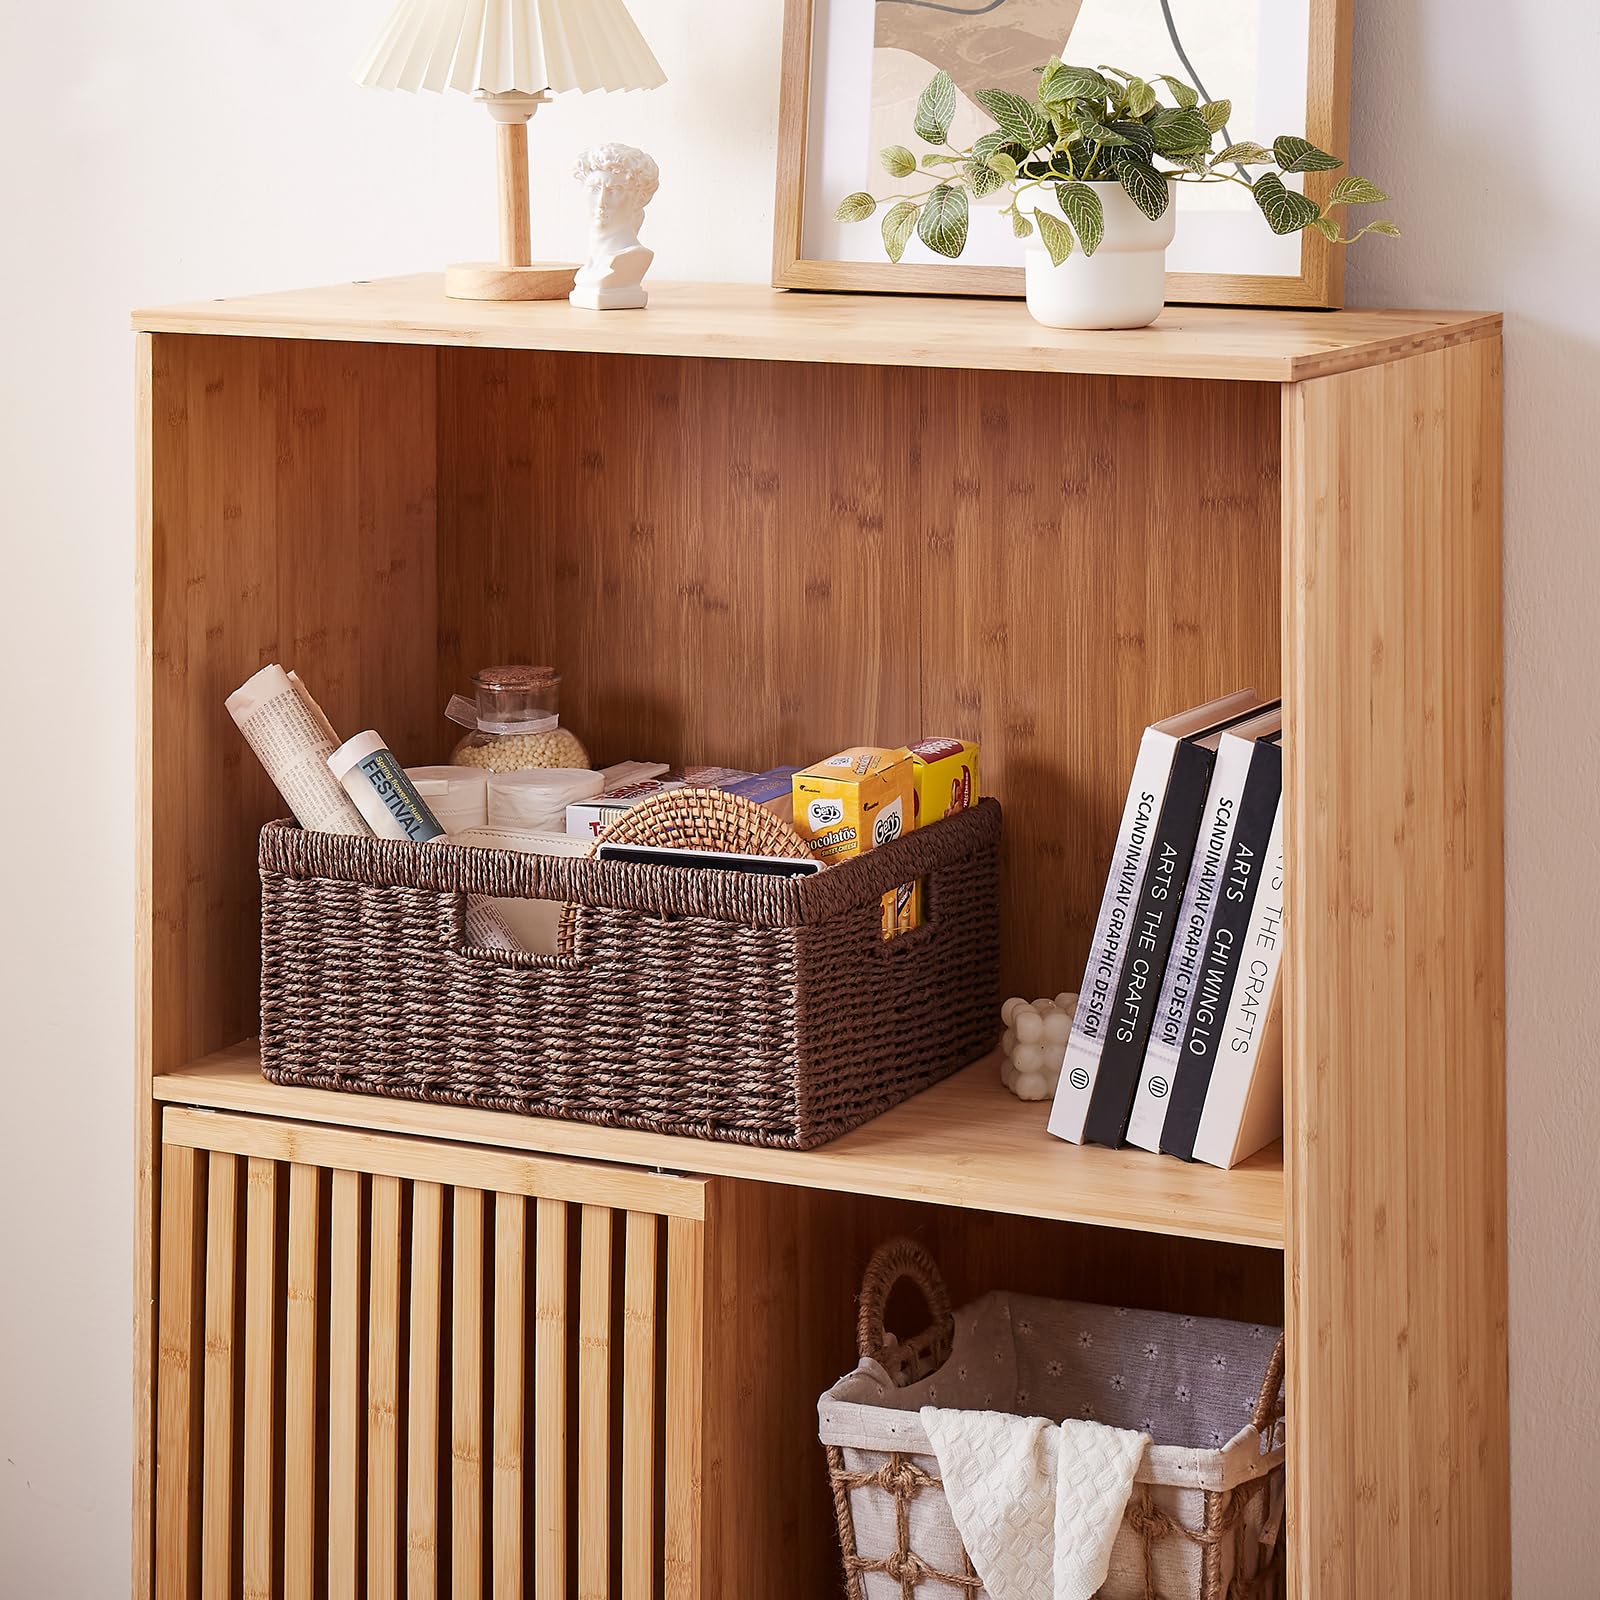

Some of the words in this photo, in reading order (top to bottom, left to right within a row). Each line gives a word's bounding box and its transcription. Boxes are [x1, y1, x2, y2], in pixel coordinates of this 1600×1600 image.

[362, 759, 421, 841] FESTIVAL
[375, 756, 393, 780] Spring
[391, 778, 411, 805] flowers
[408, 803, 424, 824] Huan
[811, 803, 841, 823] Gery
[874, 811, 900, 845] Gery
[1114, 791, 1154, 908] SCANDINAVIAV
[1194, 796, 1233, 914] SCANDINAVIAV
[1151, 841, 1178, 901] ARTS
[1226, 842, 1254, 904] ARTS
[1097, 908, 1126, 978] GRAPHIC
[1138, 911, 1162, 952] THE
[1176, 914, 1205, 986] GRAPHIC
[1212, 928, 1234, 966] CHI
[1255, 904, 1283, 953] THE
[1083, 978, 1109, 1040] DESIGN
[1116, 958, 1149, 1043] CRAFTS
[1162, 986, 1187, 1047] DESIGN
[1195, 967, 1225, 1026] WING
[1231, 959, 1268, 1054] CRAFTS
[1189, 1026, 1210, 1056] LO
